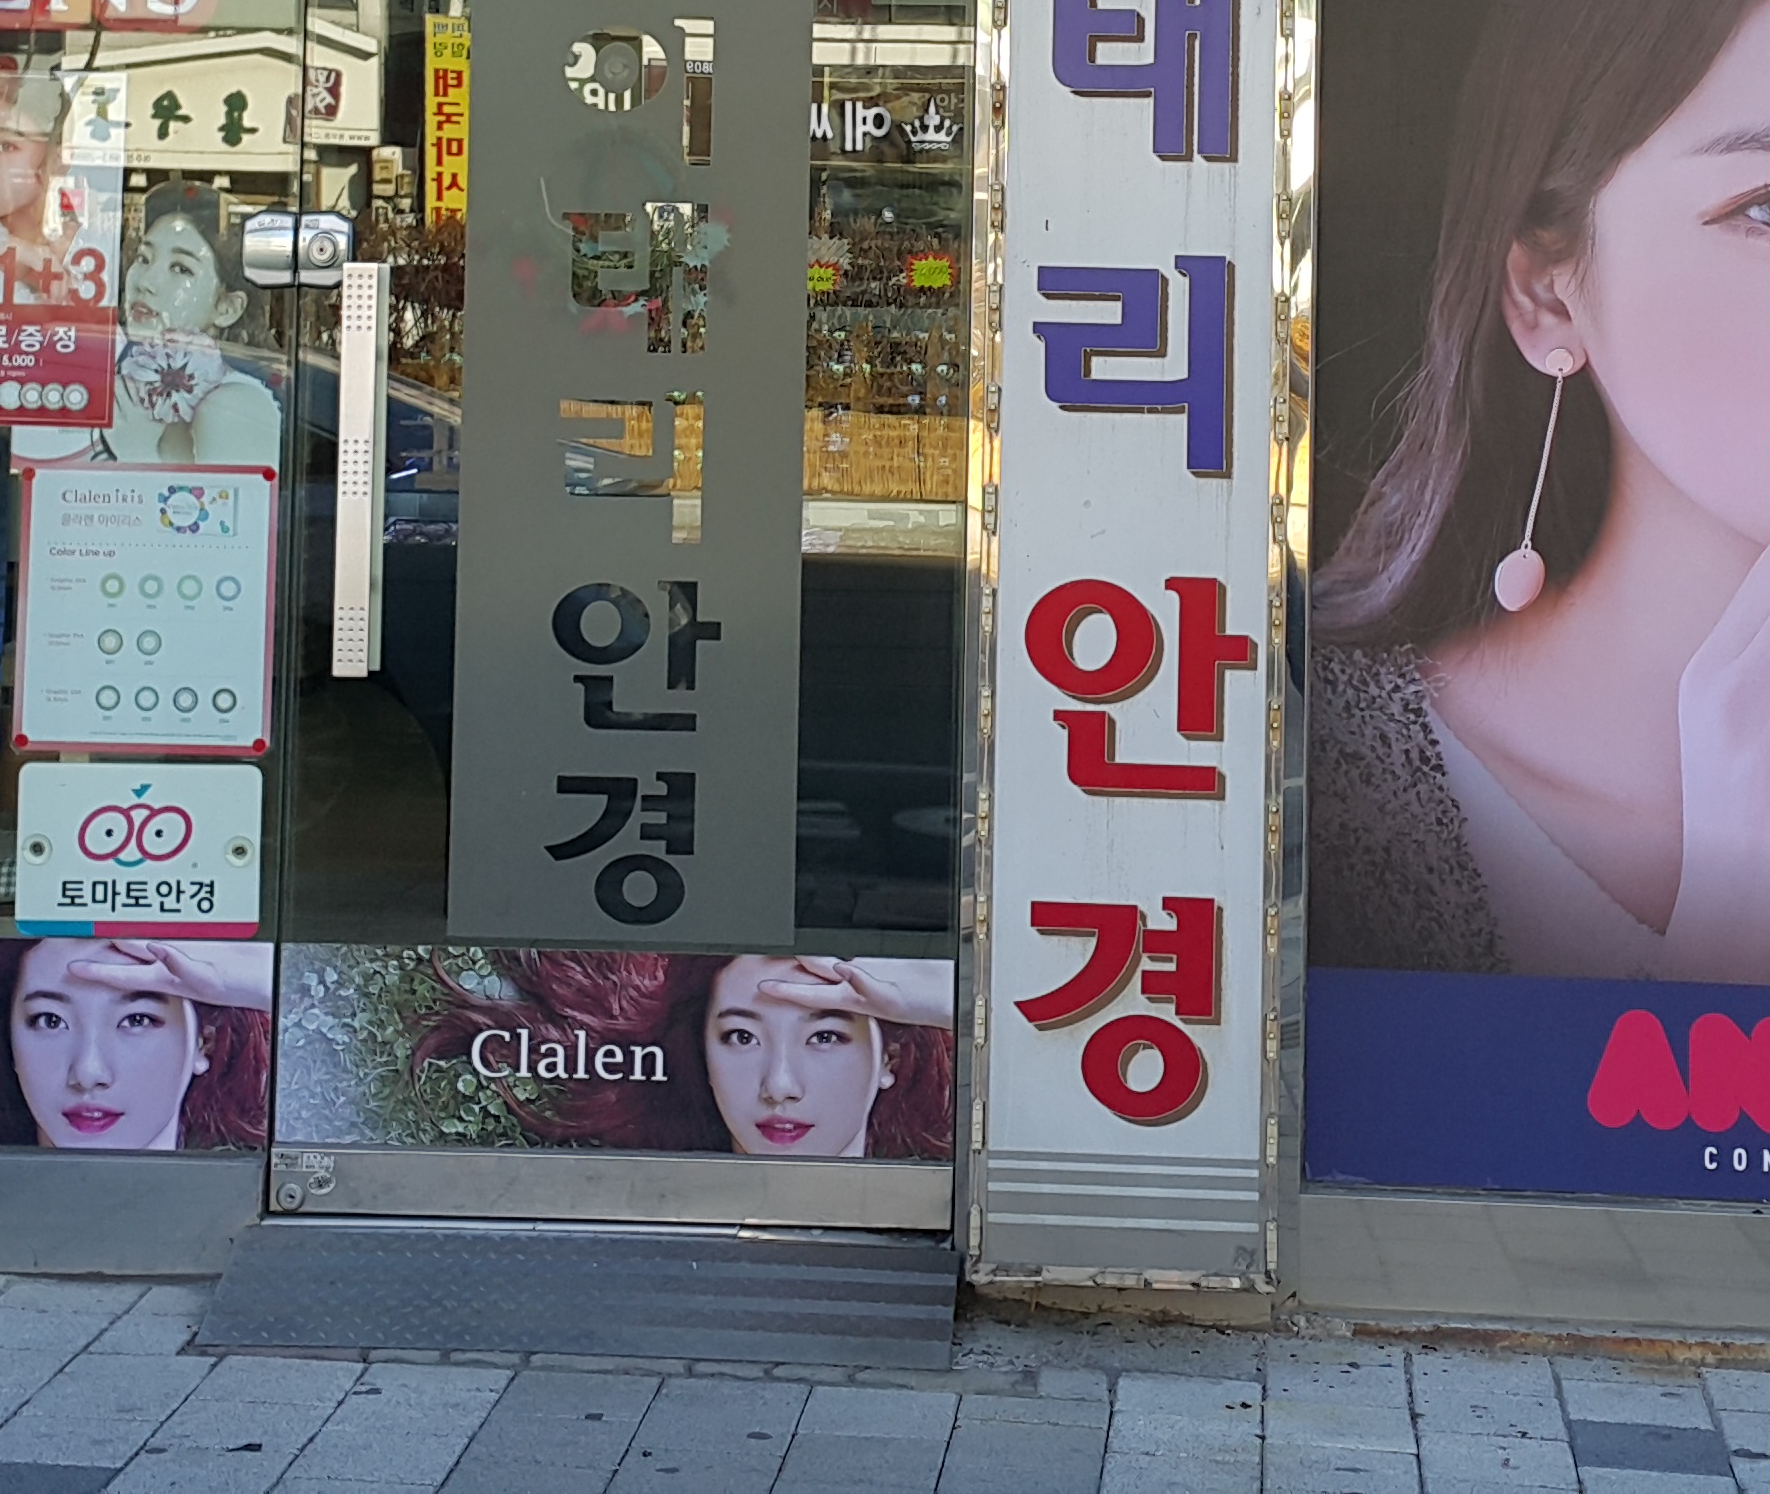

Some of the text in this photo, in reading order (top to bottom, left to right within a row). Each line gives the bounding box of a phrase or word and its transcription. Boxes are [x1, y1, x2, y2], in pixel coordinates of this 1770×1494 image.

[61, 489, 111, 504] Clalen
[49, 546, 116, 558] Color Line up
[57, 878, 217, 914] 토마토안경
[469, 1028, 669, 1083] Clalen
